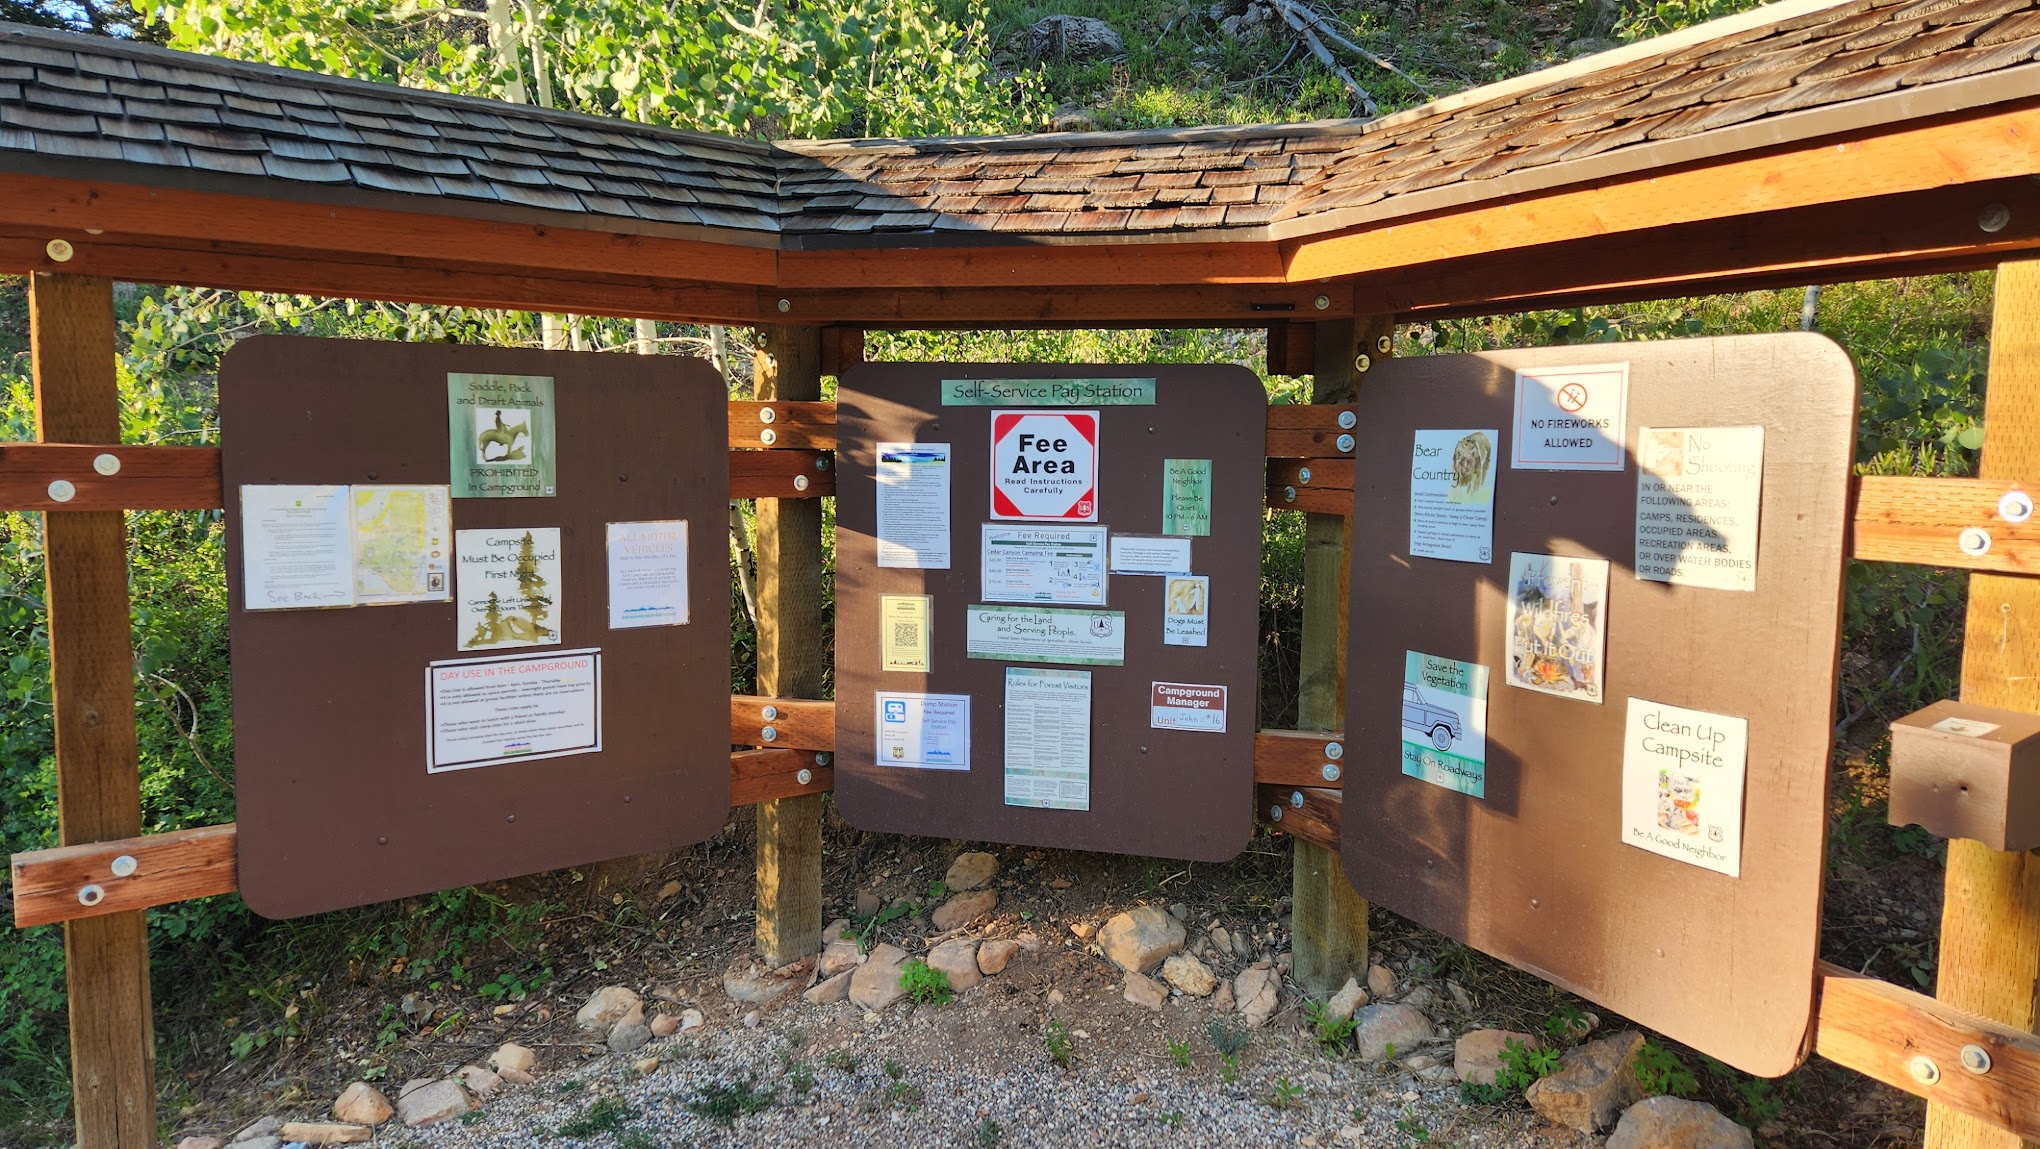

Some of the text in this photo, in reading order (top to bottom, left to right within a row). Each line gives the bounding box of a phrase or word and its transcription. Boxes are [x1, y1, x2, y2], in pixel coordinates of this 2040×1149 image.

[469, 381, 531, 392] Saddle, Pack
[953, 380, 1143, 404] Self-Service Pay Station
[456, 395, 543, 407] and Draft Animals
[1531, 419, 1609, 429] NO FIREWORKS
[1019, 434, 1068, 452] Fee
[1544, 438, 1592, 448] ALLOWED
[1688, 434, 1711, 452] No
[1415, 444, 1442, 457] Bear
[1012, 456, 1075, 474] Area
[1686, 456, 1756, 479] Shooting
[470, 468, 538, 477] PROHIBITED
[1413, 467, 1460, 488] Country
[480, 480, 540, 495] Campground
[1172, 476, 1202, 487] Neighbor
[1641, 483, 1713, 494] IN OR NEAR THE
[1640, 496, 1692, 507] FOLLOWING
[1640, 512, 1738, 527] CAMPS, RESIDENCES,
[641, 532, 678, 541] MOTOR
[1034, 532, 1070, 540] Required
[1640, 526, 1720, 539] OCCUPIED AREAS,
[486, 537, 532, 550] Campsite
[624, 544, 673, 554] VEHICLES
[1639, 538, 1732, 554] RECREATION AREAS,
[462, 555, 488, 563] Must
[507, 550, 555, 565] Occupied
[1639, 552, 1752, 569] OR OVER WATER BODIES
[510, 568, 534, 581] Night
[1639, 565, 1686, 577] OR ROADS.
[1524, 570, 1590, 593] Prevent
[267, 590, 288, 602] See
[1520, 598, 1590, 624] Wildfires
[979, 612, 1052, 624] Caring for the Land
[1168, 617, 1185, 626] Dogs
[997, 624, 1076, 638] and Serving People.
[1513, 635, 1596, 663] Put It Out
[440, 659, 588, 681] DAY USE IN THE CAMPGROUND
[1426, 660, 1465, 677] Save the
[1008, 678, 1088, 690] Rules for Forest Visitors
[1422, 670, 1468, 690] Vegetation
[1158, 686, 1220, 697] Campground
[1167, 696, 1210, 708] Manager
[1157, 717, 1176, 725] Unit
[1643, 710, 1726, 752] Clean Up
[1642, 736, 1724, 768] Campsite
[1403, 750, 1483, 785] Stay On Roadways
[1633, 827, 1726, 862] Be A Good Neighbor
